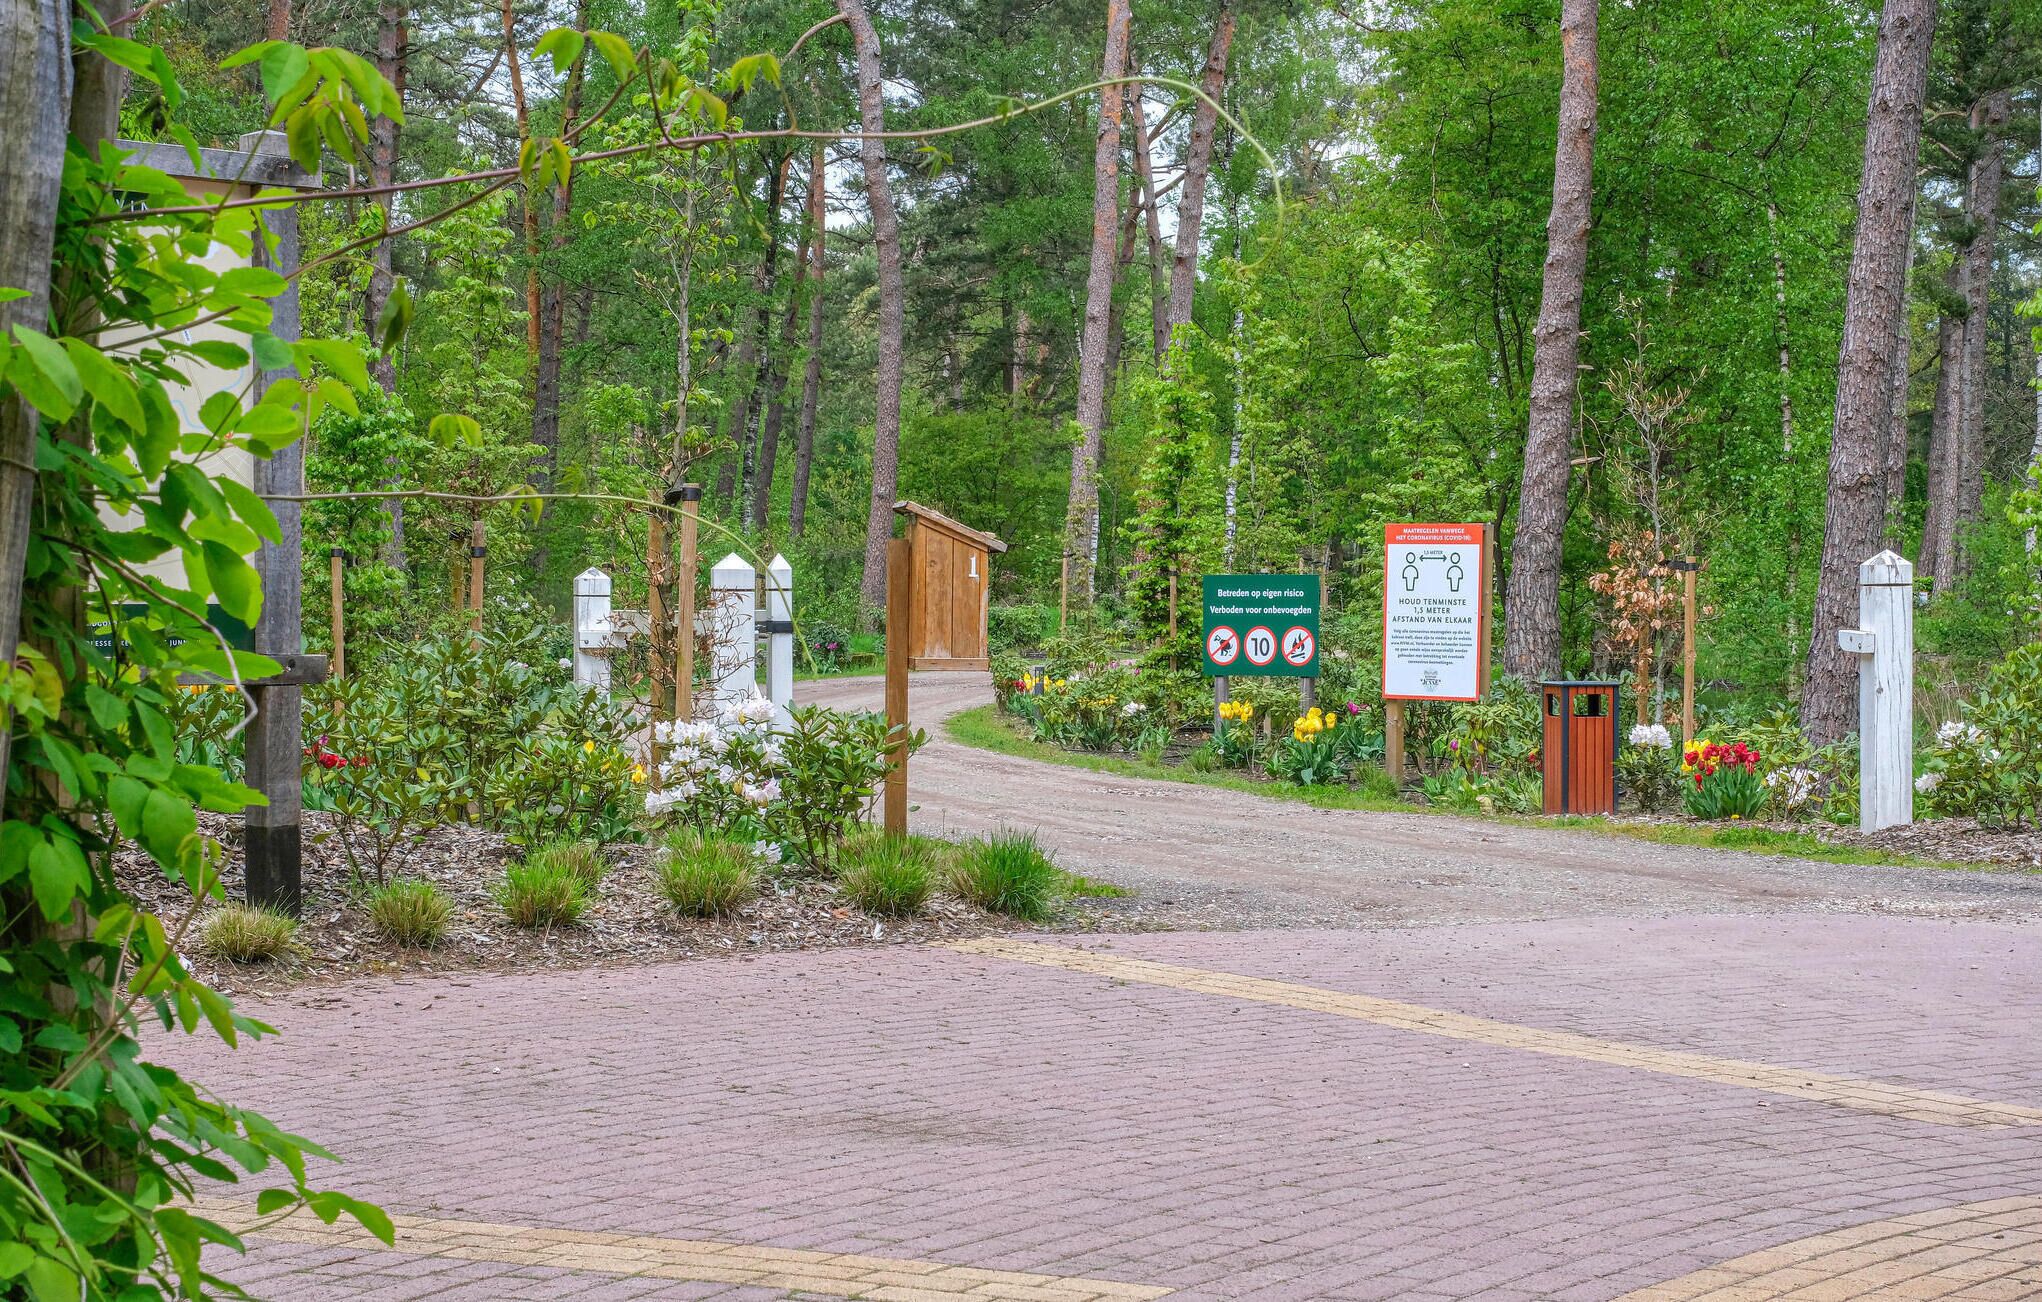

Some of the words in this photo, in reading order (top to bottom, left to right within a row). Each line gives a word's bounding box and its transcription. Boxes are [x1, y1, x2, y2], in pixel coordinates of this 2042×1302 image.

[969, 553, 979, 578] 1
[1217, 588, 1249, 597] Betreden
[1251, 590, 1261, 599] op
[1262, 588, 1282, 599] eigen
[1284, 588, 1304, 597] risico
[1424, 598, 1467, 606] TENMINSTE
[1210, 605, 1243, 614] Verboden
[1263, 605, 1312, 616] onbevoegden
[1414, 606, 1424, 614] 1,5
[1445, 616, 1472, 624] ELKAAR
[1251, 637, 1270, 656] 10
